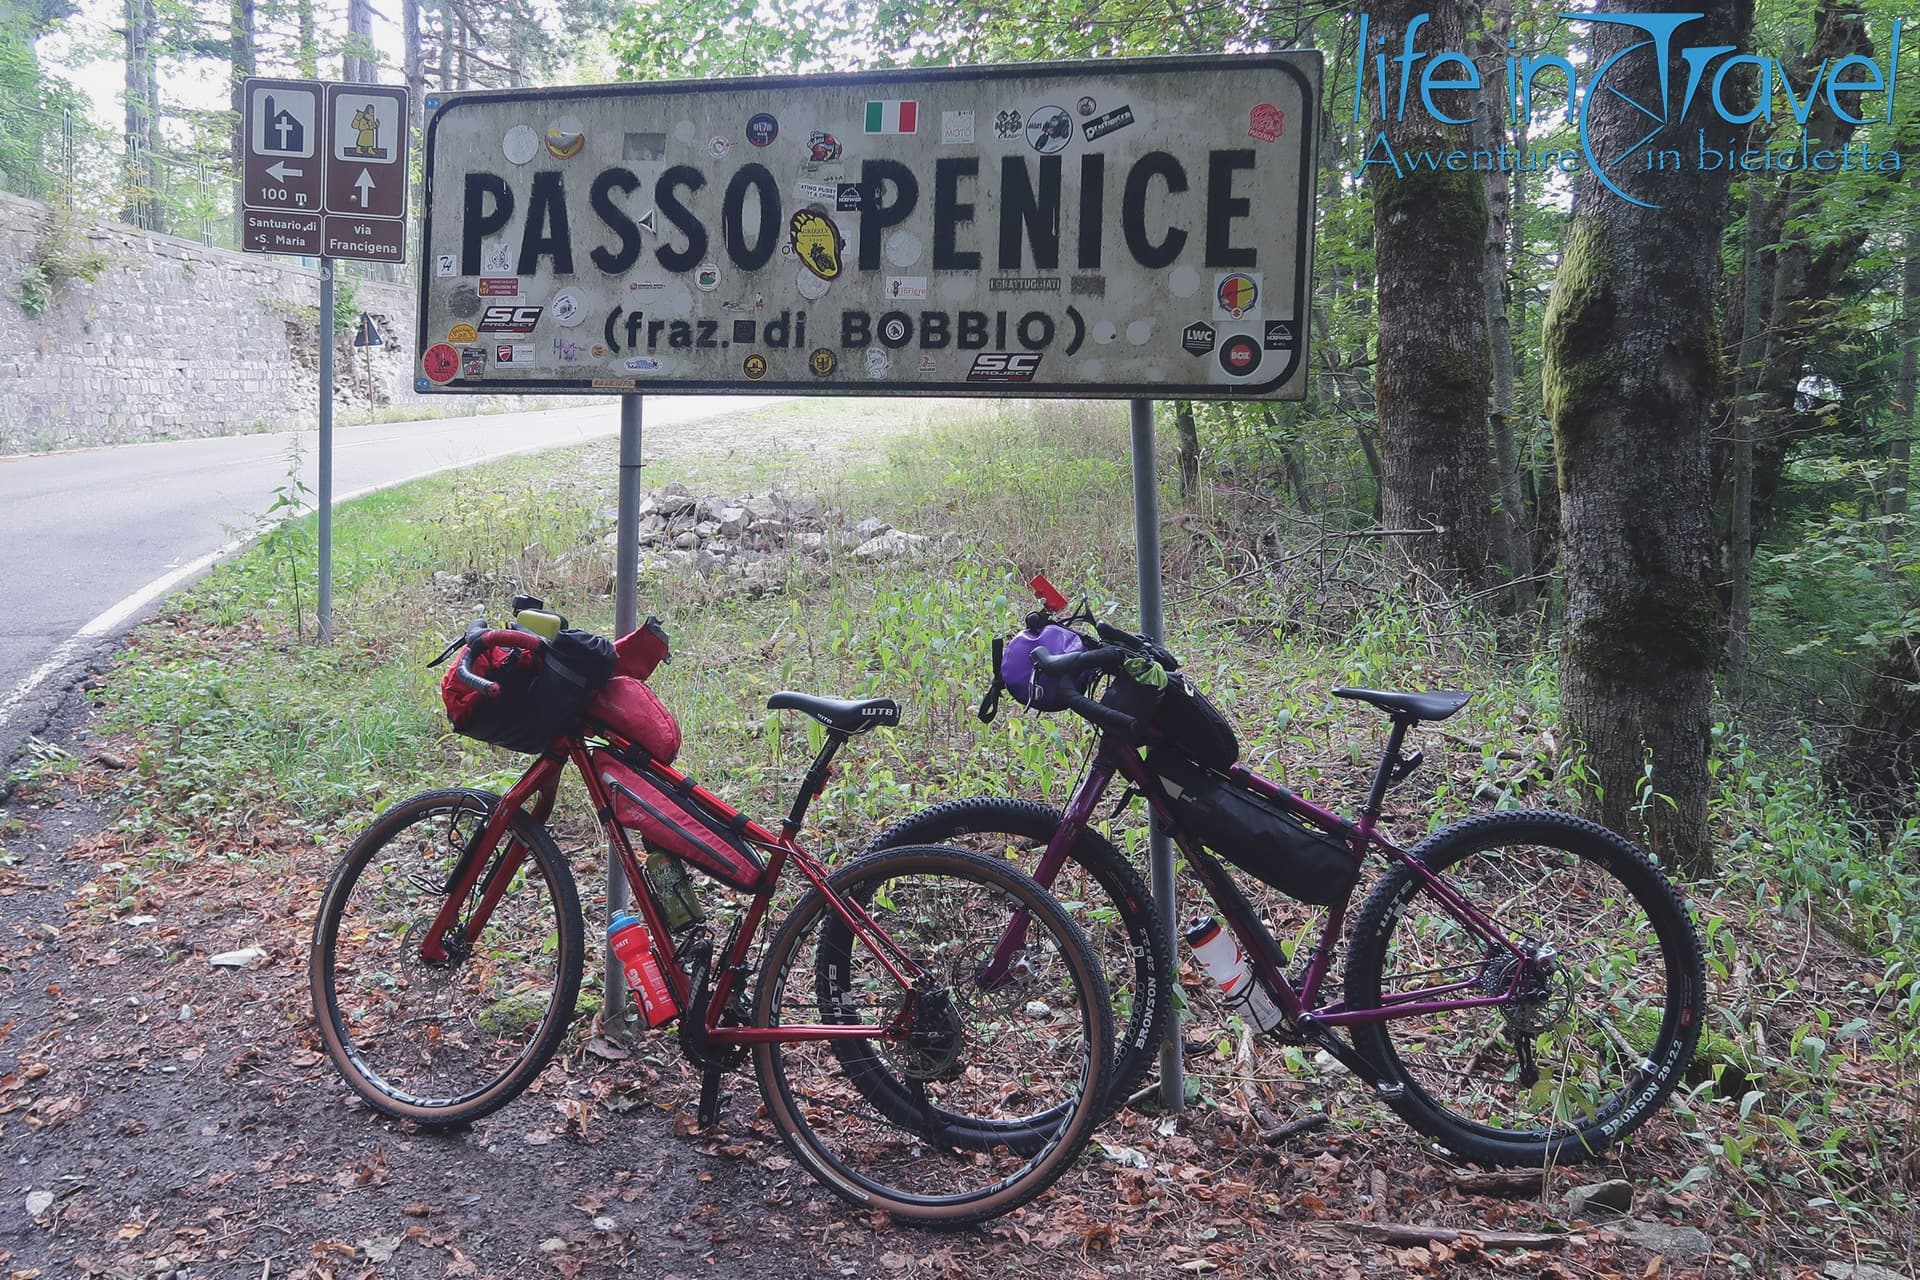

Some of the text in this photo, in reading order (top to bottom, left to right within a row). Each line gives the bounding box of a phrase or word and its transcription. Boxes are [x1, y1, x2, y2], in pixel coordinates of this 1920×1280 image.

[261, 188, 307, 203] 100 m
[463, 149, 1257, 275] PASSO PENICE
[249, 217, 317, 231] Santuario di
[354, 224, 372, 236] via
[259, 233, 306, 246] S. Maria
[329, 238, 397, 255] Francigena
[484, 308, 540, 323] SC
[604, 306, 730, 354] (fraz.
[763, 311, 806, 348] di
[841, 304, 1086, 357] BOBBIO)
[1186, 329, 1213, 341] LWC
[974, 354, 1039, 370] SC
[861, 708, 894, 716] WTB
[1134, 976, 1157, 1051] BRONSON
[1600, 1080, 1661, 1137] BRONSON
